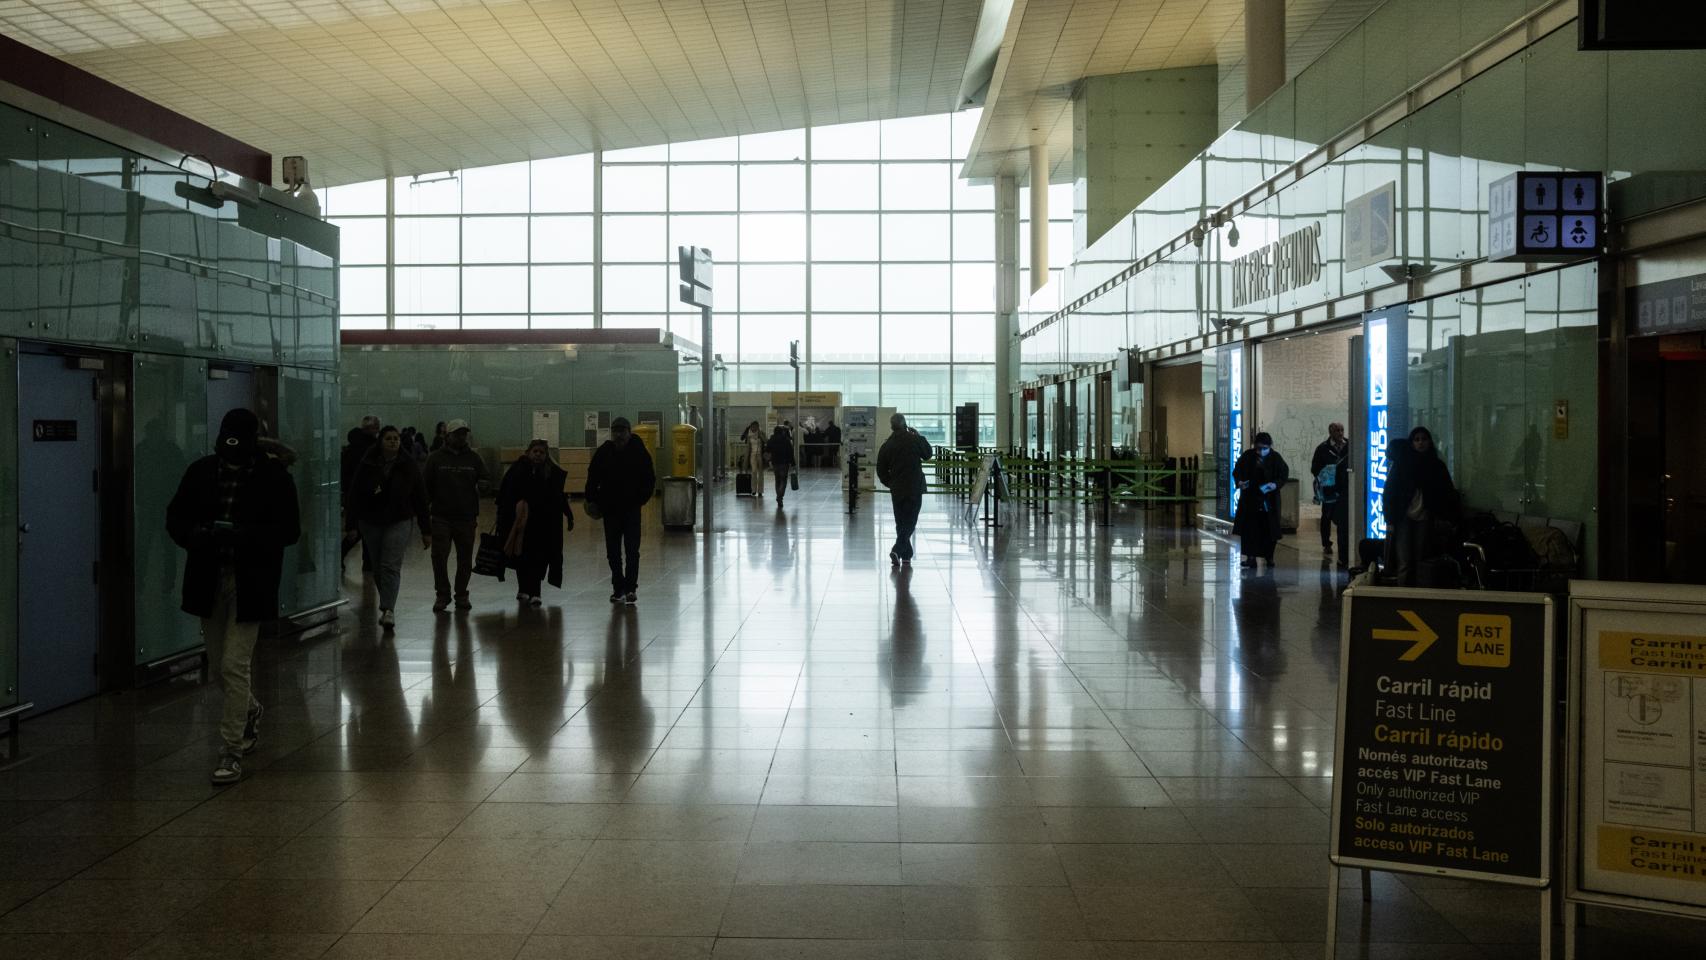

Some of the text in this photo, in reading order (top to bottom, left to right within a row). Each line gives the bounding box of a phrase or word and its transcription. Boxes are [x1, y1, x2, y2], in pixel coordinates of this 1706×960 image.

[1231, 254, 1247, 308] TAX
[1248, 244, 1270, 304] FREE
[1272, 221, 1321, 296] REFUNDS
[1370, 431, 1379, 492] FREE
[1464, 625, 1503, 639] FAST
[1464, 643, 1504, 656] LANE
[1630, 638, 1692, 650] Carril
[1630, 648, 1705, 660] Fast lane
[1630, 657, 1692, 670] Carril
[1376, 675, 1492, 702] Carril rápid
[1375, 699, 1456, 722] Fast Line
[1374, 724, 1504, 752] Carril rápido
[1358, 747, 1489, 770] Només autoritzats
[1403, 768, 1427, 782] VIP
[1430, 771, 1462, 786] Fast
[1465, 774, 1502, 790] Lane
[1356, 781, 1481, 804] Only authorized VIP
[1355, 799, 1469, 823] Fast Lane access
[1354, 816, 1475, 841] Solo autorizados
[1353, 836, 1510, 863] acceso VIP Fast Lane
[1630, 835, 1694, 852] Carril
[1630, 847, 1668, 859] Fast
[1630, 858, 1695, 875] Carril
